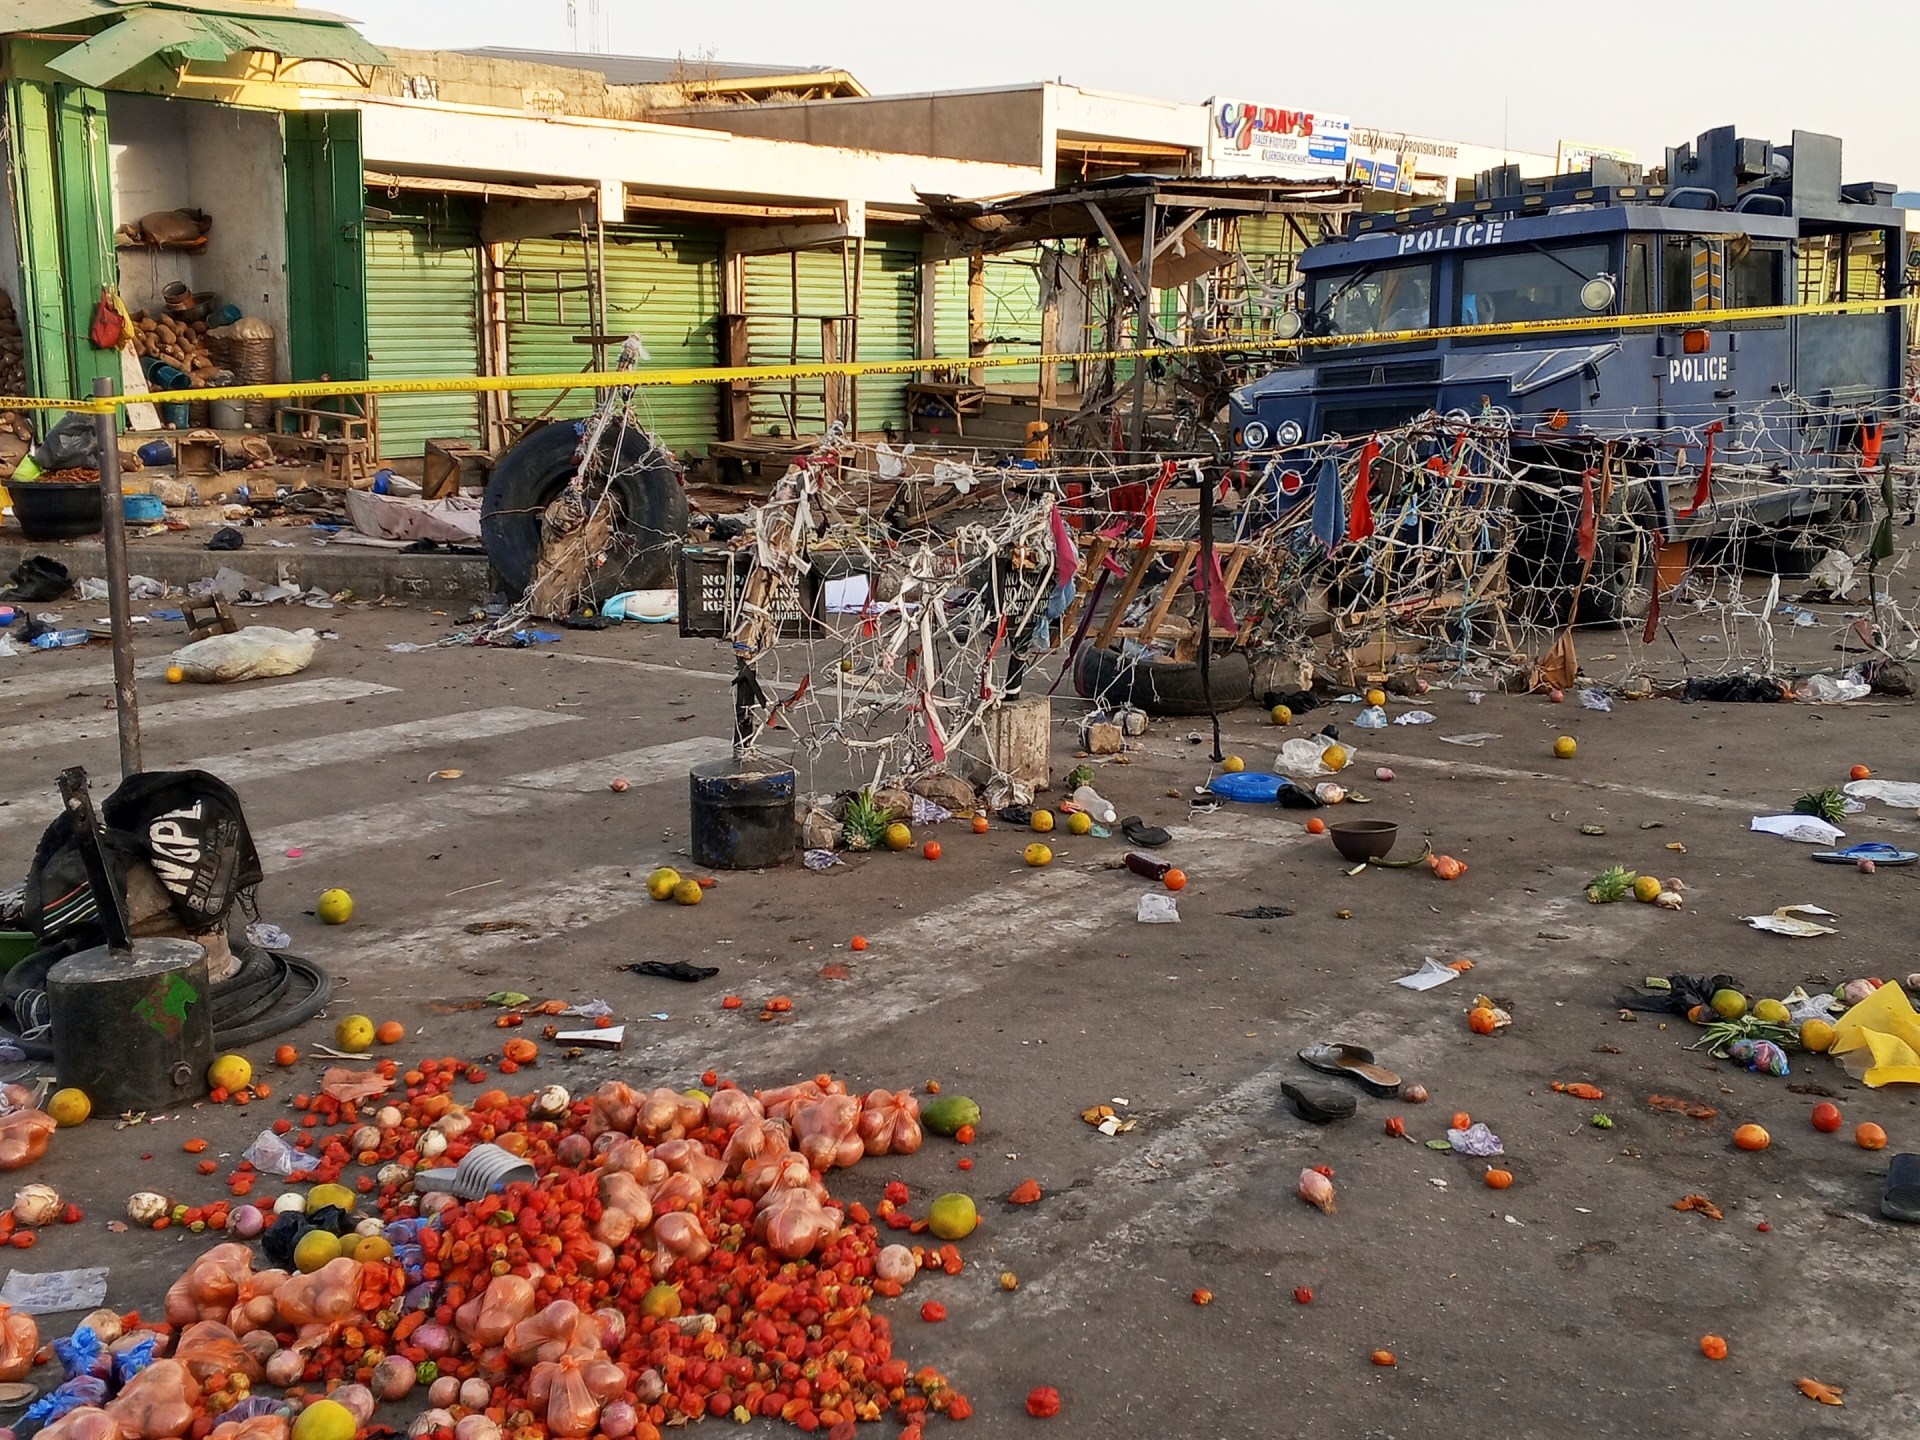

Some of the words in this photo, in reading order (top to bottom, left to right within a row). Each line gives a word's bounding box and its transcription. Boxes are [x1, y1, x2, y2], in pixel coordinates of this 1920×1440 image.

[1398, 222, 1504, 255] POLICE
[1670, 356, 1727, 385] POLICE
[702, 574, 726, 587] NO
[1005, 572, 1018, 587] NO
[702, 587, 726, 599] NO
[702, 600, 734, 612] KEE
[187, 852, 221, 913] BUILD
